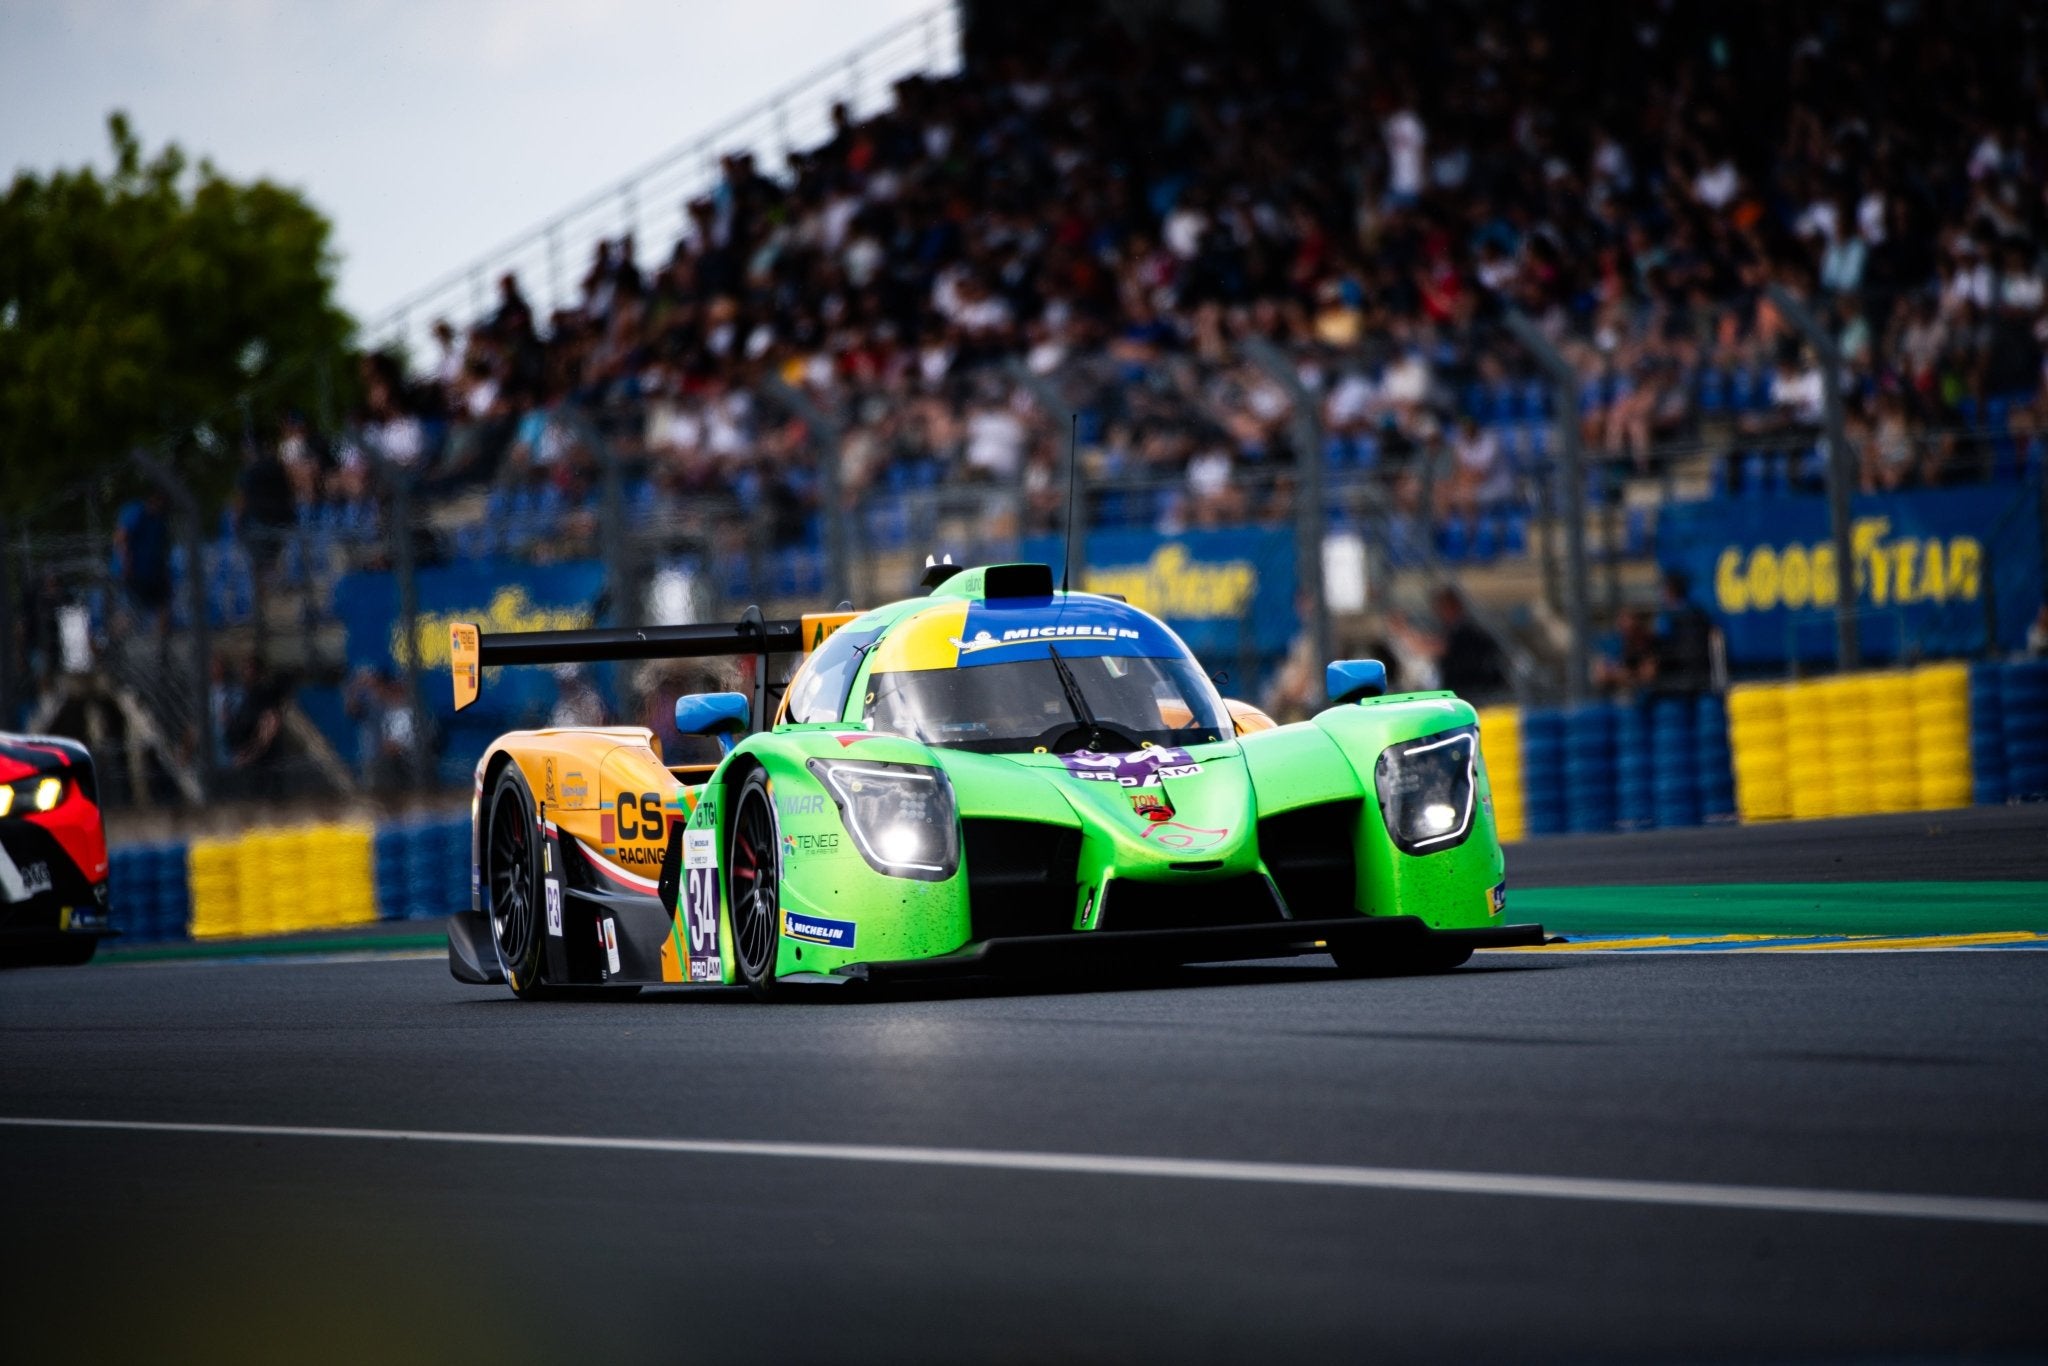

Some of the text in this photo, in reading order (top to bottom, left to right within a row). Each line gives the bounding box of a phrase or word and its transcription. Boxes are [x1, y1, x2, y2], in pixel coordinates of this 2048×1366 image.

[1003, 626, 1139, 640] MICHELIN
[1130, 795, 1158, 807] TOW
[617, 791, 664, 840] CS
[797, 834, 839, 849] TENEG
[619, 848, 665, 864] RACING
[690, 868, 716, 951] 34
[794, 922, 844, 938] MICHELIN
[691, 960, 720, 977] PRO AM
